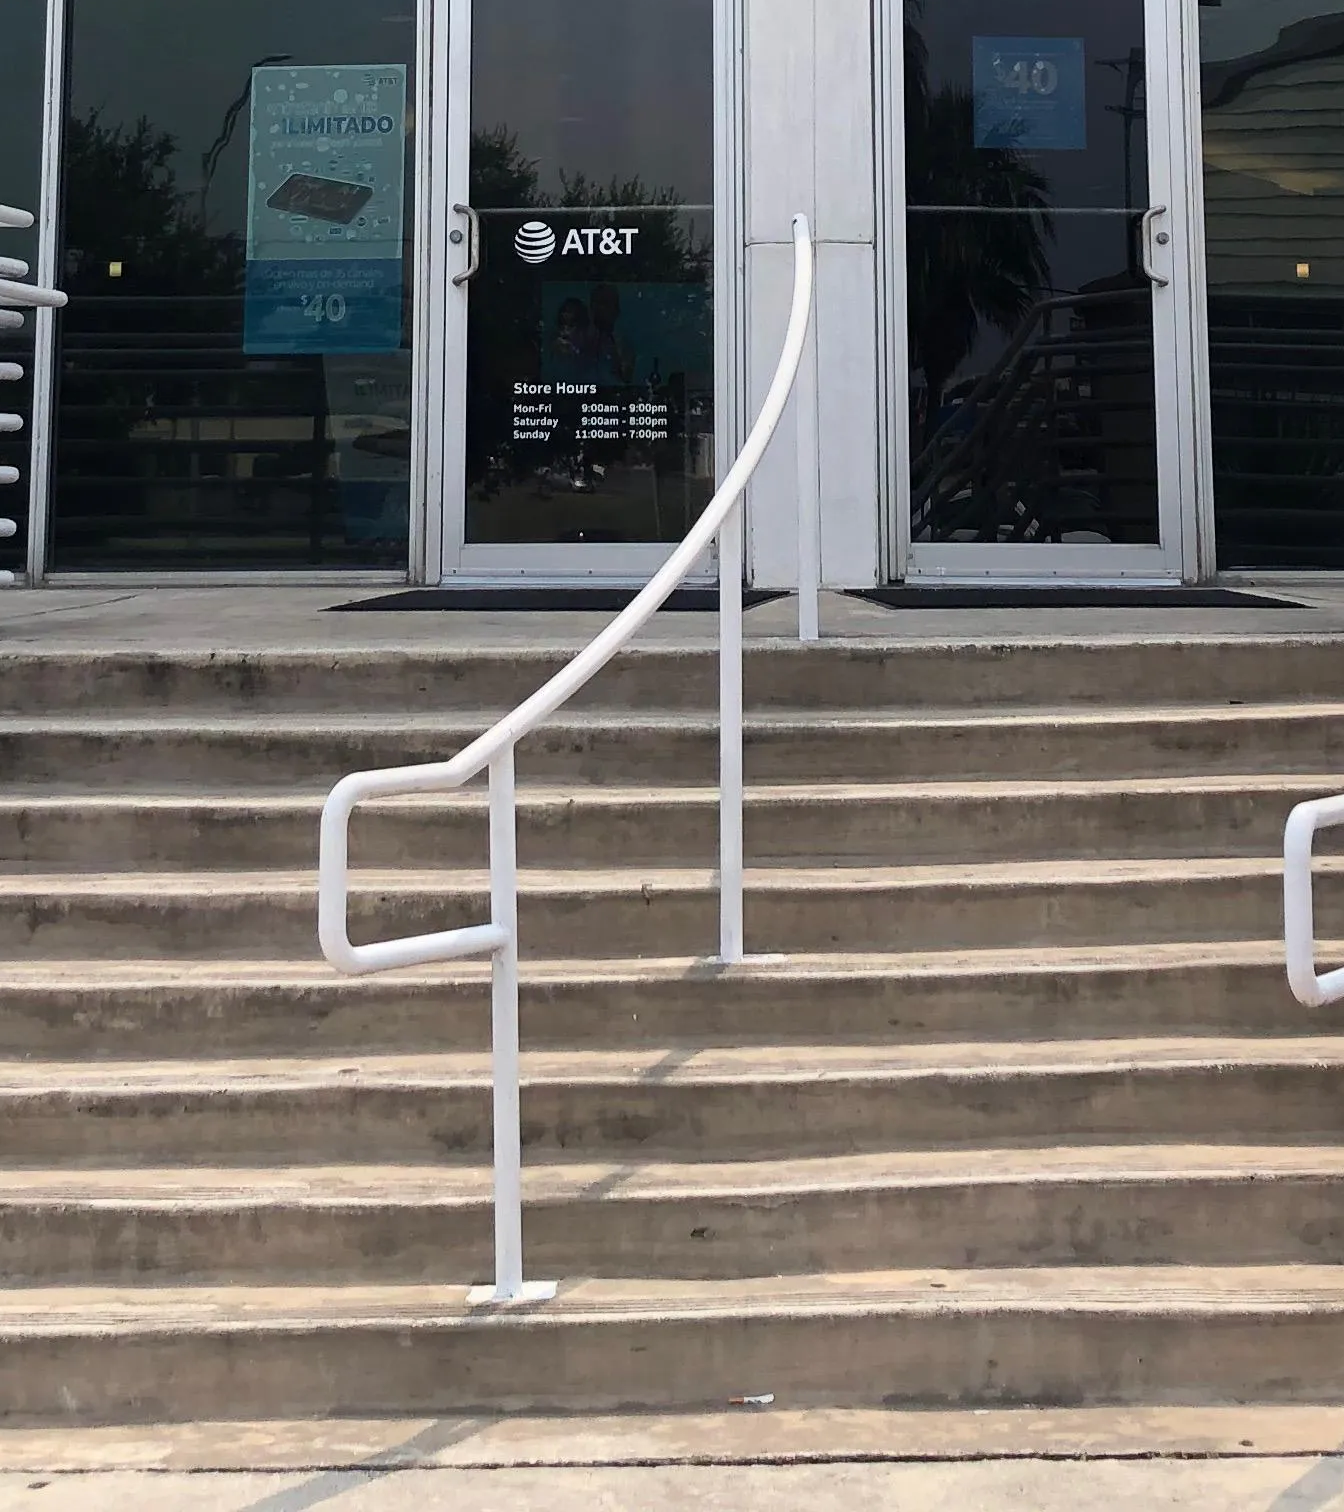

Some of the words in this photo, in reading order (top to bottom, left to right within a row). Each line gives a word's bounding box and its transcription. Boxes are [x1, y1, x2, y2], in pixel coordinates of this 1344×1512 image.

[281, 115, 394, 134] ILIMITADO
[561, 228, 639, 255] AT&T
[300, 294, 346, 322] $40
[513, 382, 552, 394] Store
[556, 382, 597, 394] Hours
[513, 403, 552, 413] Mon-Fri
[581, 403, 619, 413] 9:00am
[629, 403, 667, 416] 9:00pm
[513, 417, 558, 428] Saturday
[581, 416, 619, 426] 9:00am
[629, 416, 667, 428] 8:00pm
[513, 429, 550, 441] Sunday
[575, 429, 619, 439] 11:00am
[629, 429, 667, 441] 7:00pm
